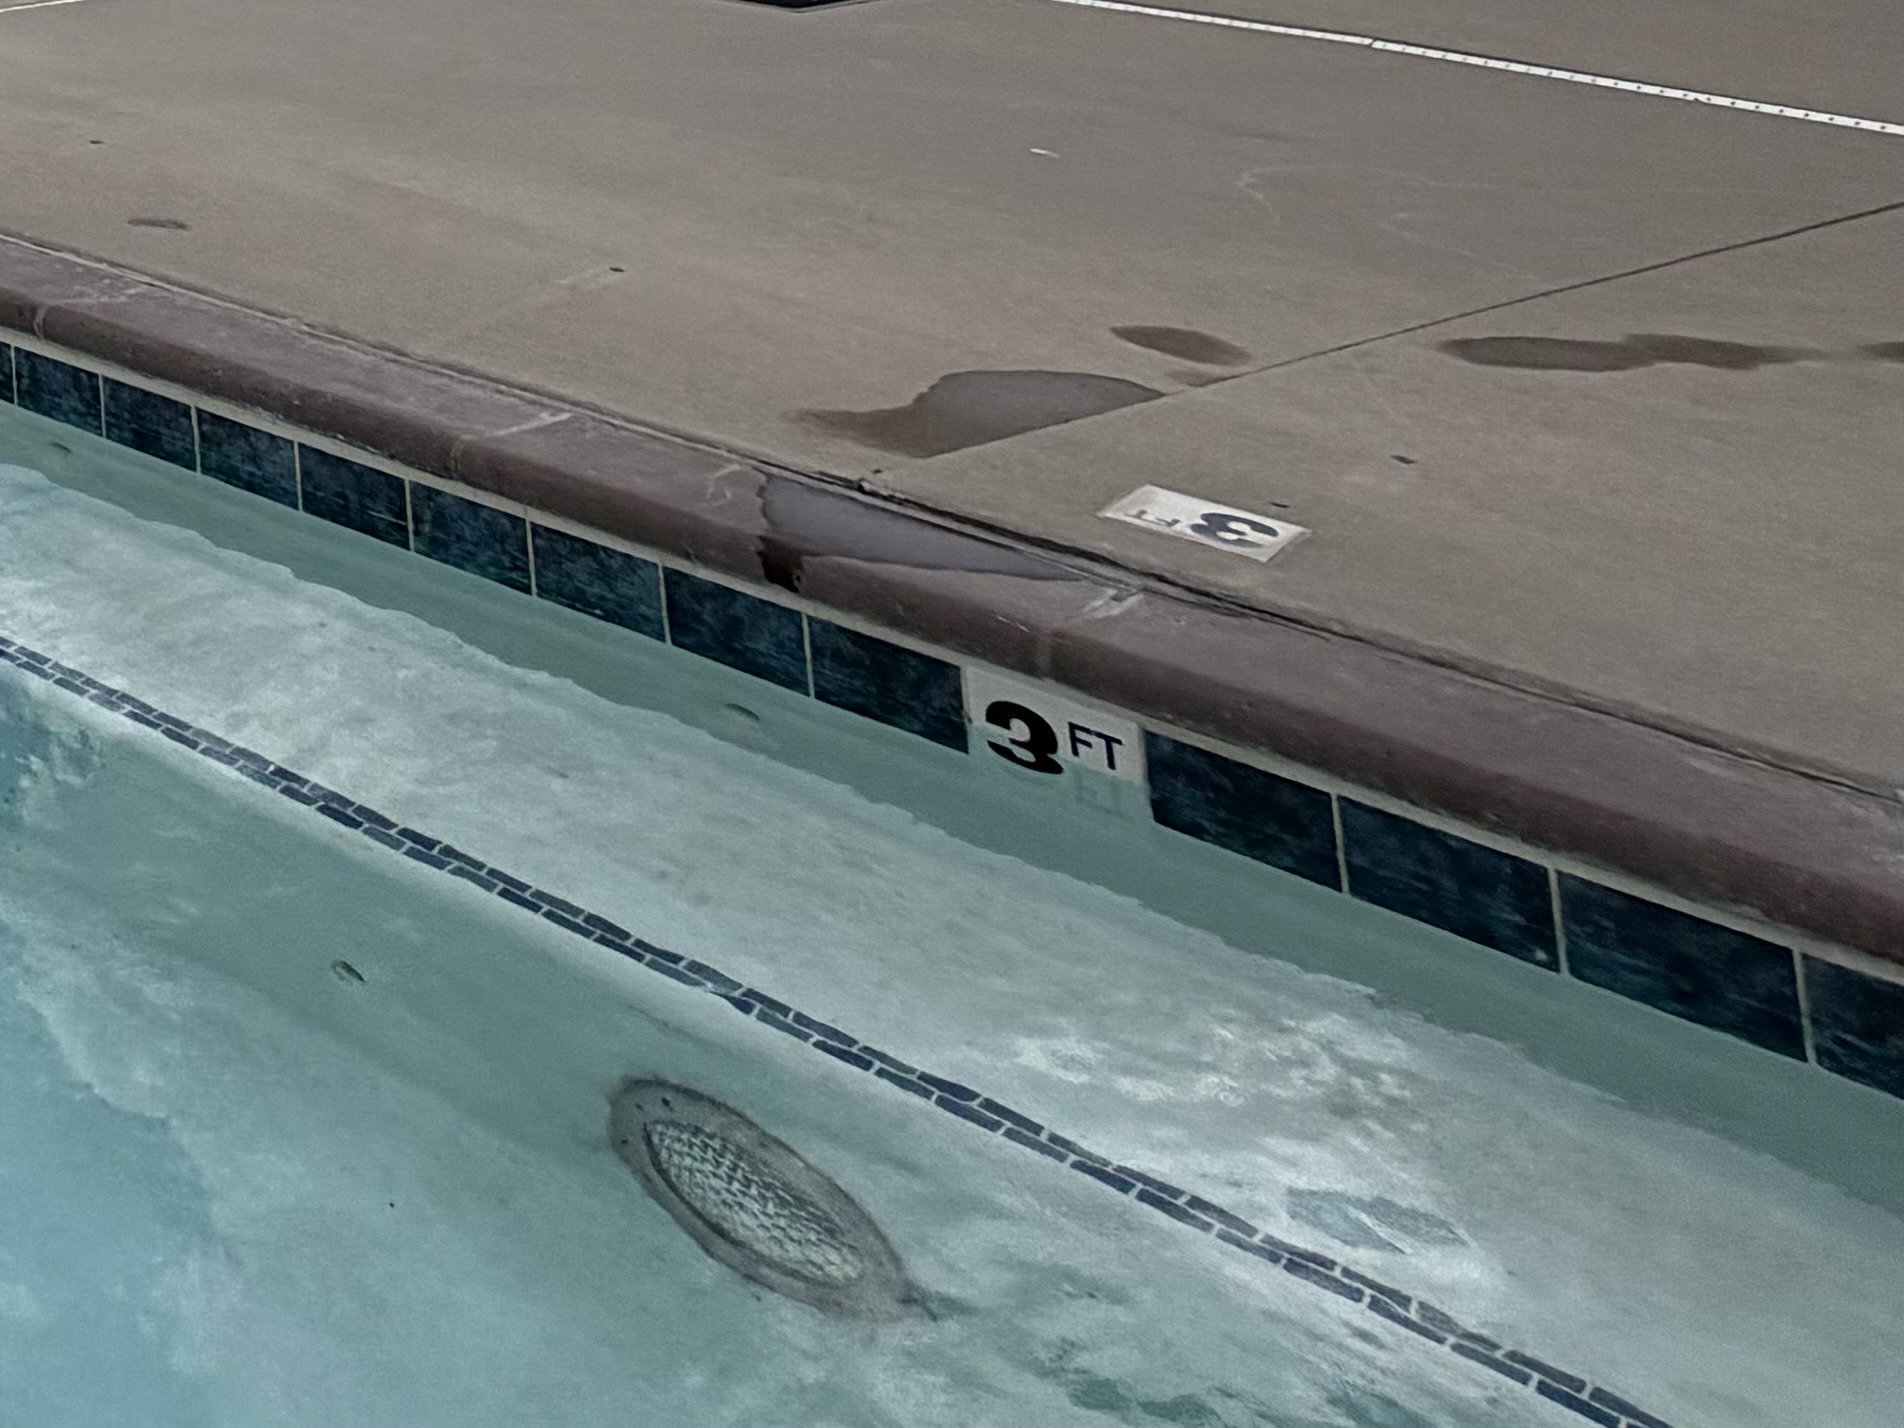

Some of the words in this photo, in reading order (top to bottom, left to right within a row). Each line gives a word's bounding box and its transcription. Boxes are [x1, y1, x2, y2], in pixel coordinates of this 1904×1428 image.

[1190, 512, 1280, 549] 3
[985, 700, 1065, 776] 3
[1067, 721, 1124, 771] FT
